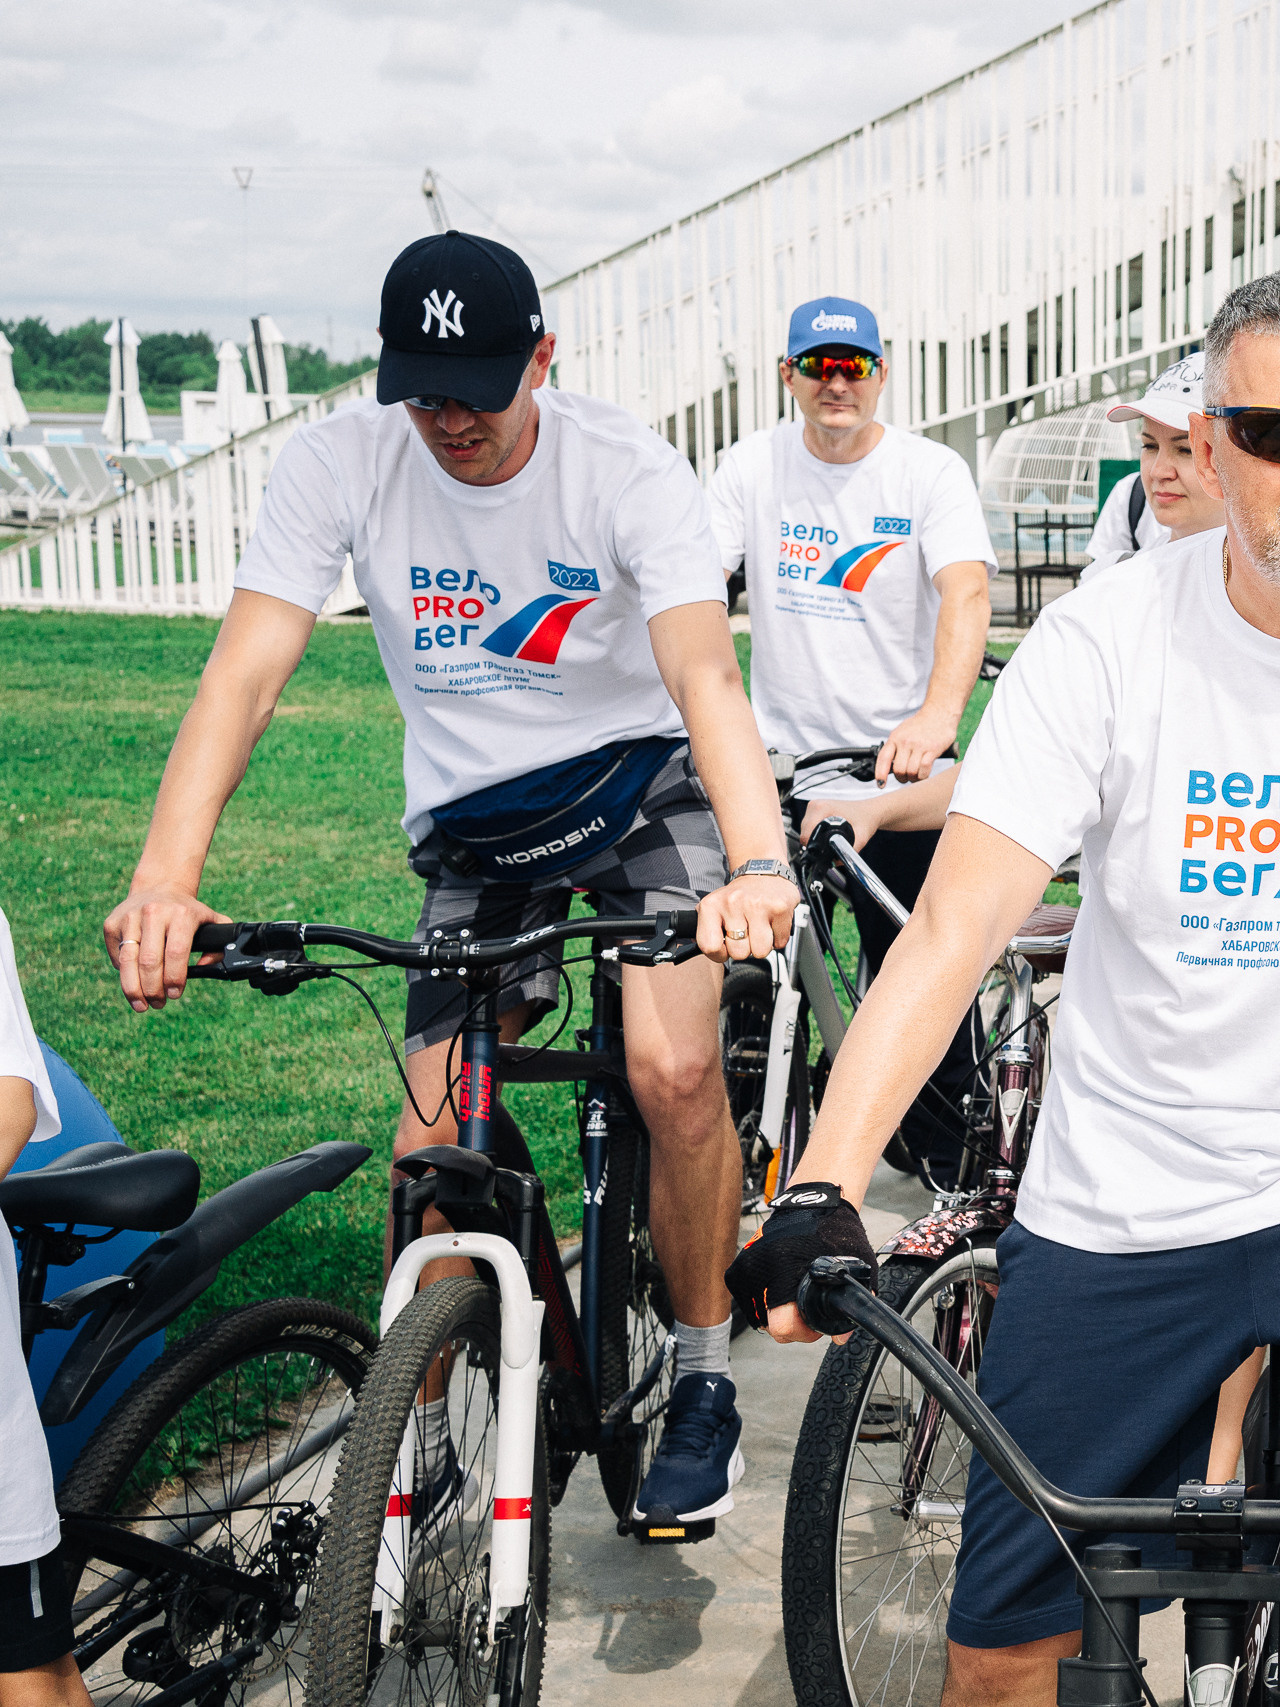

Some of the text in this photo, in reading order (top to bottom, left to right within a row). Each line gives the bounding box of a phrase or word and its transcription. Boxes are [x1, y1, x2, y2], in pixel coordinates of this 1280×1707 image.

[422, 289, 464, 338] NY
[875, 518, 909, 534] 2022
[780, 541, 820, 562] PRO
[549, 565, 596, 589] 2022
[413, 595, 485, 621] PRO
[448, 673, 502, 687] ХАБАРОВСКОЕ
[495, 816, 606, 866] NORDSKI
[1180, 914, 1210, 929] ООО
[1213, 917, 1273, 933] «Газпром
[1176, 951, 1233, 967] Первичная
